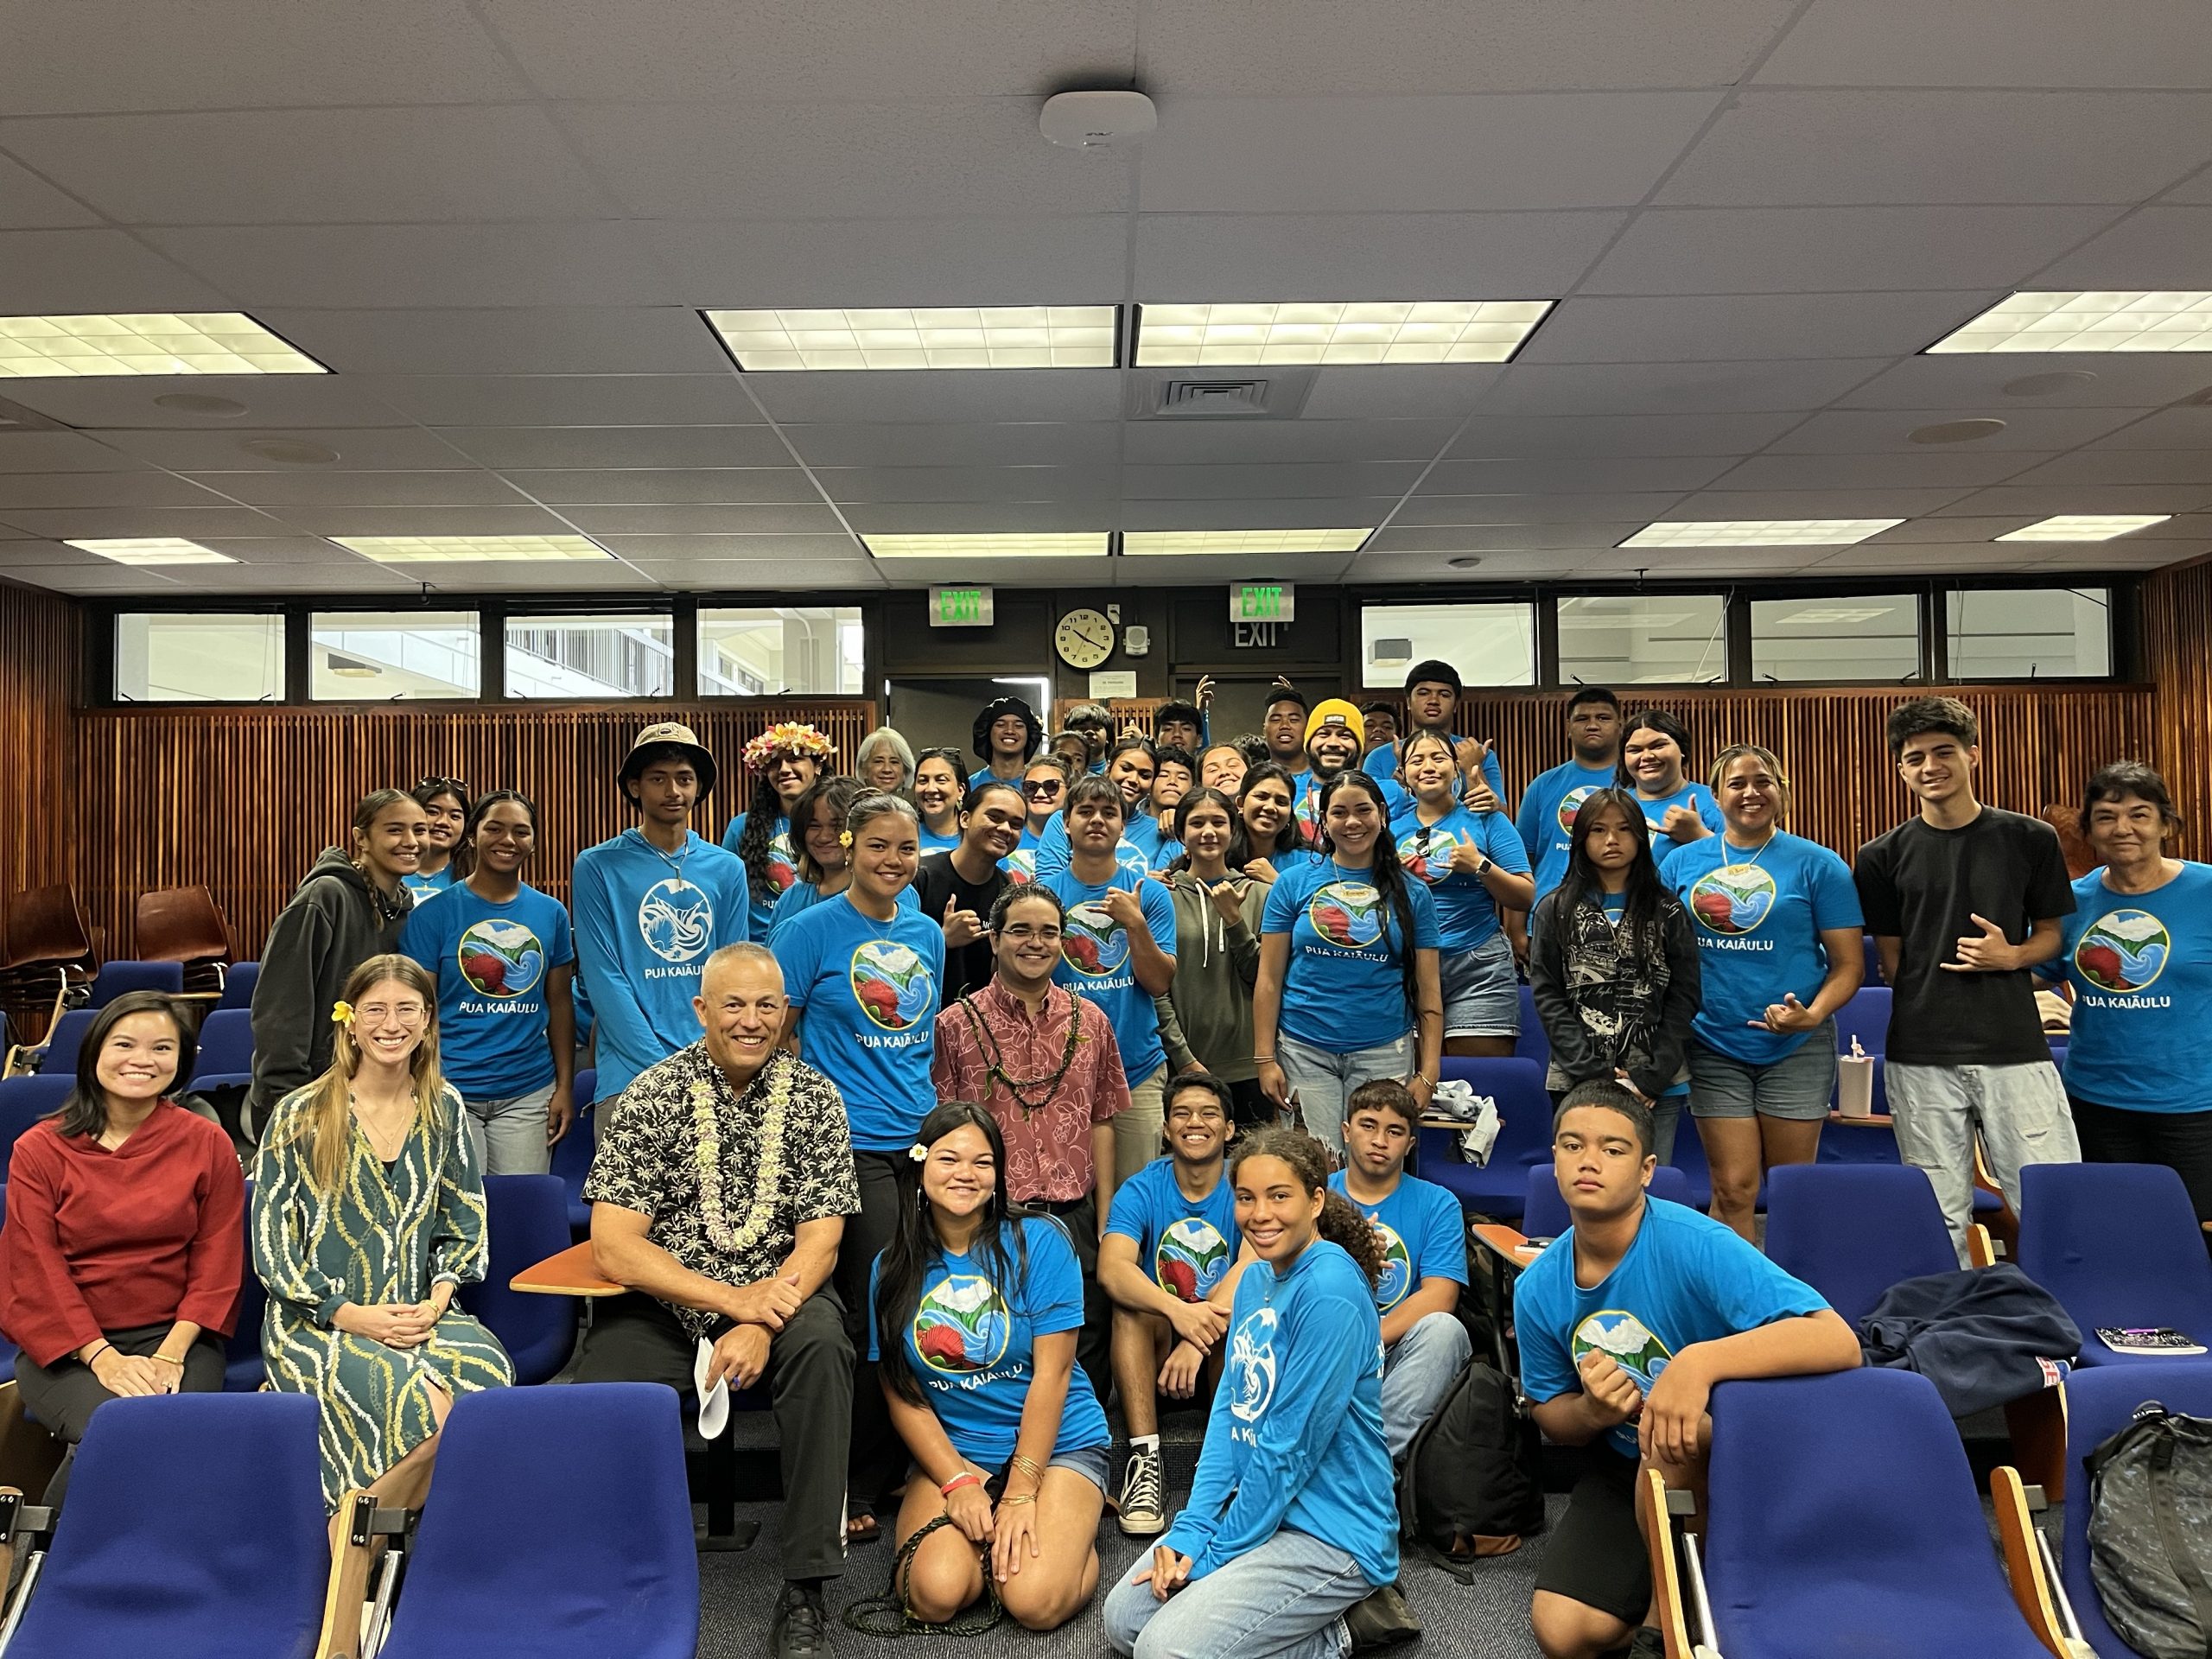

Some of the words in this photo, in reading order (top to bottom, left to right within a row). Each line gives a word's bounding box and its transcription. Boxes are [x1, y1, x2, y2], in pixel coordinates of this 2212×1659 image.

[940, 590, 982, 622] EXIT
[1242, 587, 1282, 617] EXIT
[762, 899, 777, 909] PU
[1697, 937, 1713, 948] UA
[1716, 938, 1774, 950] KAIĀULU
[1305, 945, 1331, 957] PUA
[1333, 950, 1389, 963] KAIĀULU
[645, 968, 666, 979] PUA
[668, 963, 705, 977] KAIĀU
[1063, 982, 1085, 992] PUA
[1087, 976, 1135, 991] KAIĀULU
[459, 1001, 484, 1014] PUA
[486, 1000, 539, 1014] KAIĀULU
[2107, 995, 2171, 1009] KAIĀULU
[855, 1033, 881, 1048] PUA
[928, 1379, 961, 1392] PU
